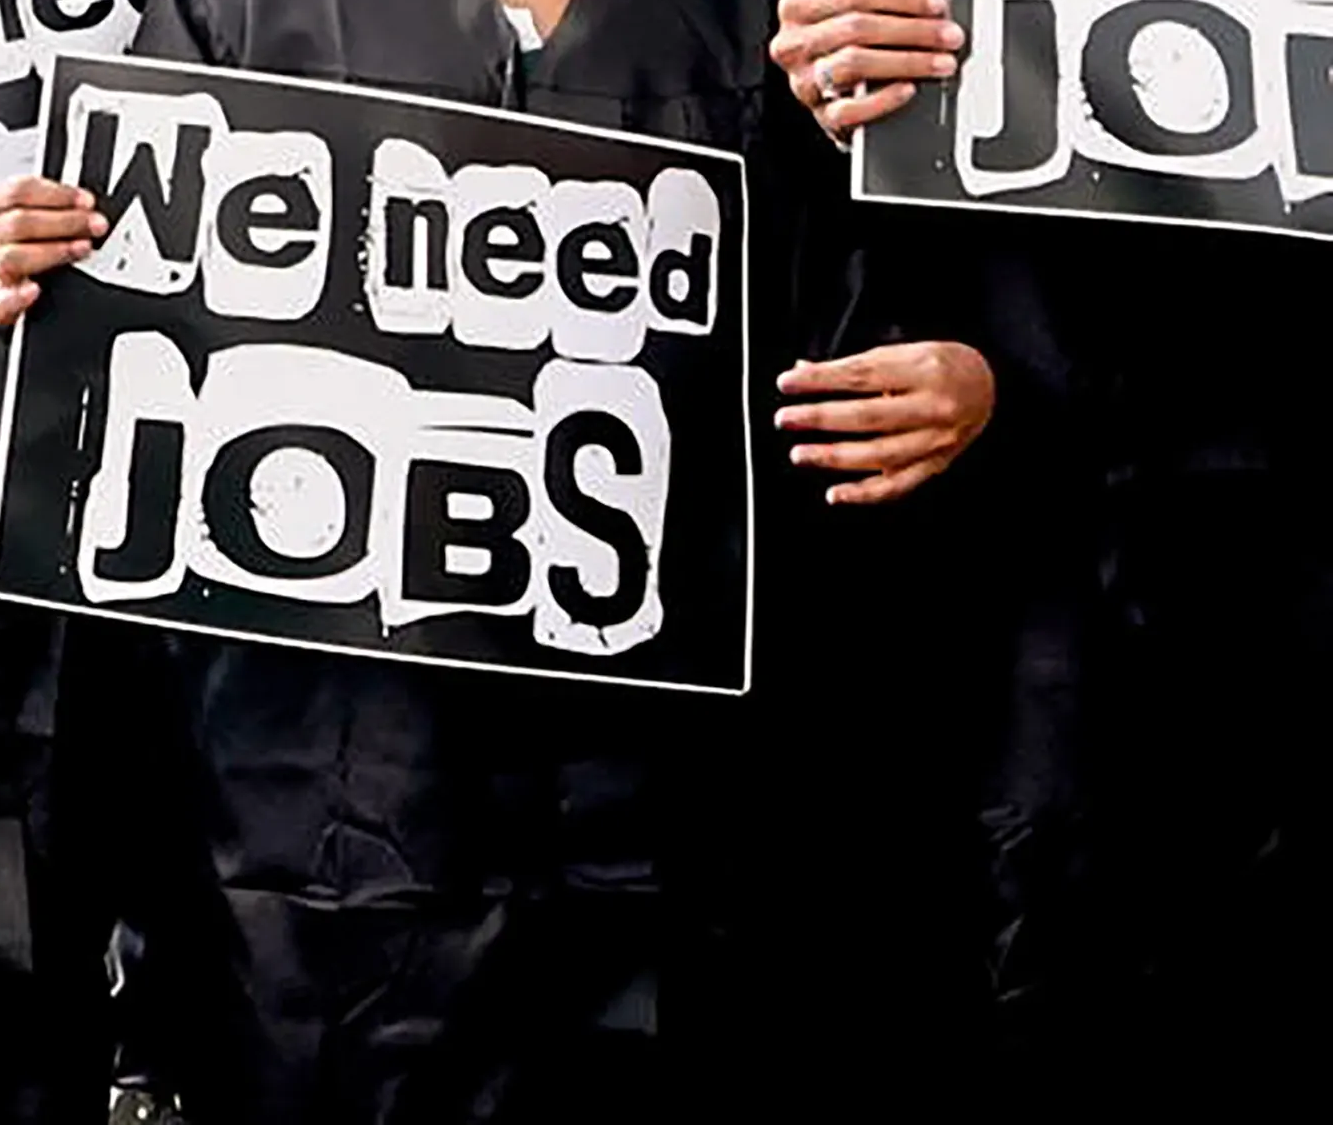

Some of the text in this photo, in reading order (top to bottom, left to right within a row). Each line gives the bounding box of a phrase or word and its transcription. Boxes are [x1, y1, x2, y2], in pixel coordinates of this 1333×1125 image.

[79, 111, 712, 325] We need
[92, 409, 651, 629] JOBS
